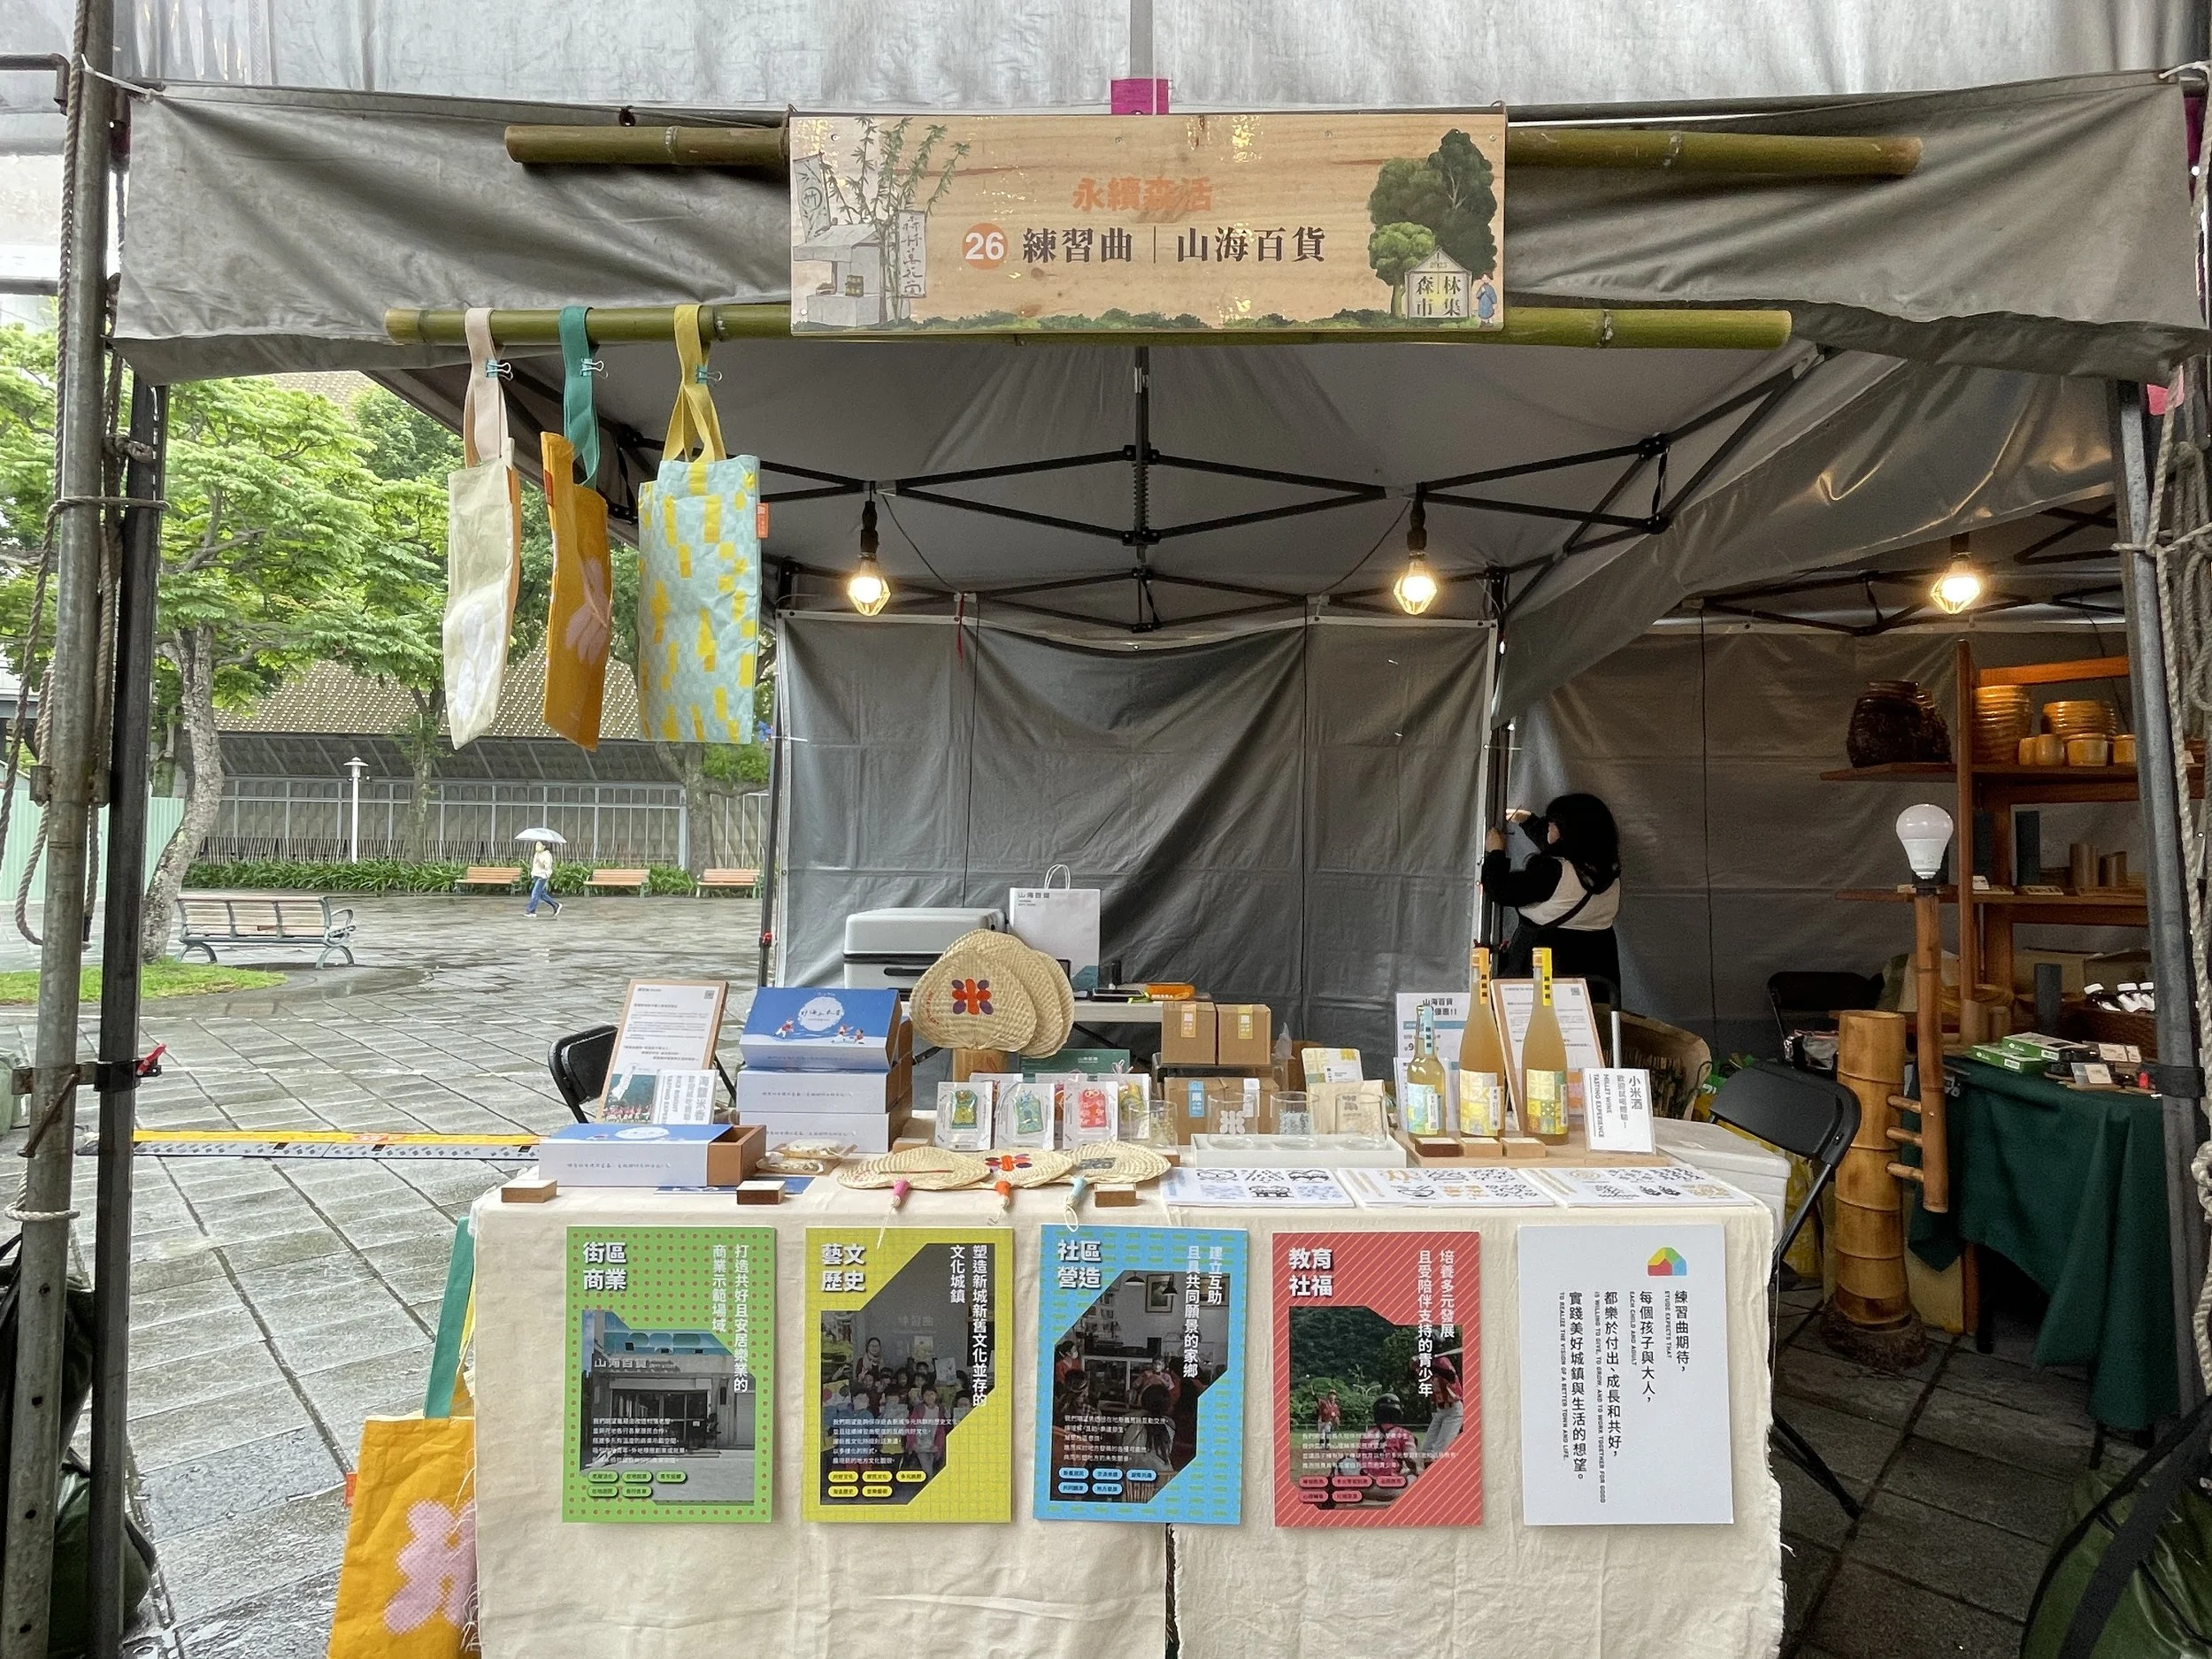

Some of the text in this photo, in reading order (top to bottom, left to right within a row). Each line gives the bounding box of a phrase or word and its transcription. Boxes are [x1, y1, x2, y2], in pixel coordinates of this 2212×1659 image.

[964, 232, 1005, 260] 26
[1022, 226, 1326, 264] 練習曲 山海百貨
[1416, 276, 1462, 295] 森林
[1416, 297, 1461, 317] 市集
[1423, 997, 1454, 1006] 山海百貨
[1629, 1075, 1643, 1110] 小米酒
[1595, 1101, 1605, 1138] EXPERIENCE
[582, 1241, 626, 1263] 街區
[821, 1243, 865, 1266] 藝文
[1058, 1239, 1102, 1262] 社區
[1288, 1248, 1333, 1271] 教育
[582, 1268, 626, 1291] 商業
[711, 1243, 727, 1333] 商業示範場域
[821, 1270, 865, 1293] 歷史
[950, 1244, 965, 1304] 文化城鎮
[1057, 1266, 1102, 1289] 營造
[1207, 1246, 1224, 1306] 建立互助
[1288, 1274, 1333, 1297] 社福
[1183, 1245, 1202, 1379] 且具共同願景的家鄉
[1440, 1249, 1455, 1339] 培養多元發展
[733, 1243, 749, 1393] 打造共好且安居樂業的
[972, 1244, 988, 1407] 塑造新城新舊文化並存的
[1417, 1249, 1433, 1397] 且受陪伴支持的青少年
[1674, 1290, 1690, 1372] 練習曲期待，
[1639, 1290, 1656, 1402] 每個孩子與大人，
[1569, 1291, 1587, 1479] 實踐美好城鎮與生活的想望。
[1604, 1291, 1623, 1457] 都樂於付出、成長和共好，
